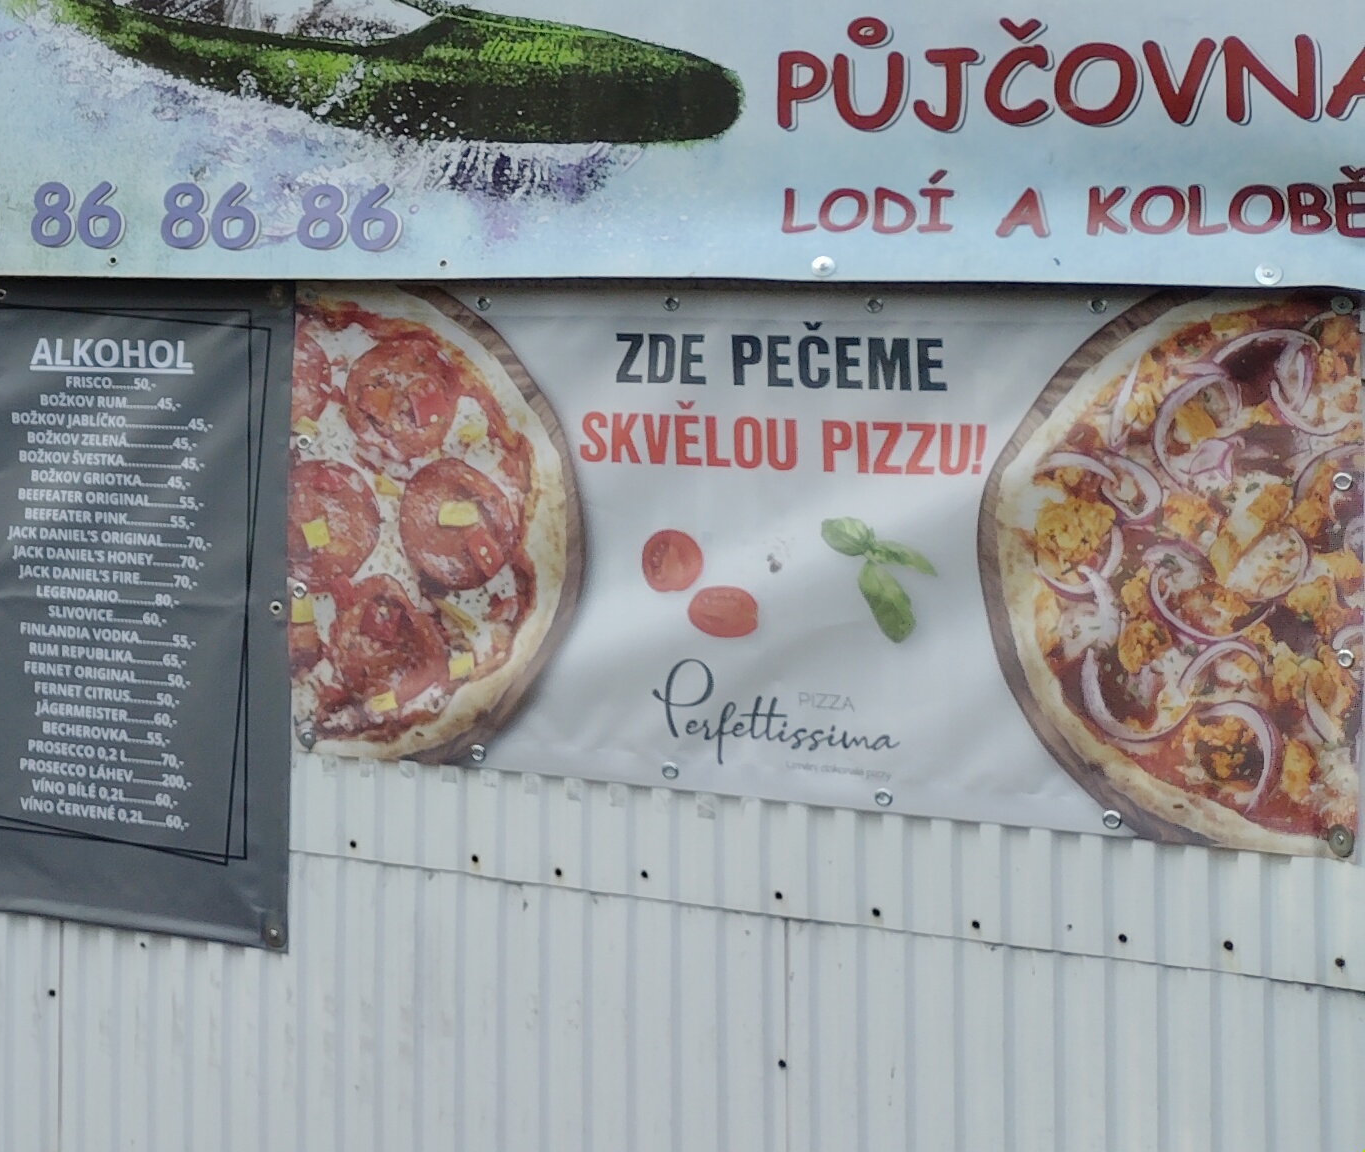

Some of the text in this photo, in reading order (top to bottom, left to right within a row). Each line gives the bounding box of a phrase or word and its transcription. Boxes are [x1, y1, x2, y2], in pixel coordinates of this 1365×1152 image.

[31, 180, 124, 250] 86
[160, 180, 259, 251] 86
[296, 181, 404, 253] 86
[781, 169, 953, 237] LODÍ
[996, 187, 1049, 237] A
[30, 338, 194, 369] ALKOHOL
[615, 321, 948, 391] ZDE PEČEME
[40, 393, 95, 407] BOŽKOV
[579, 400, 987, 476] SKVĚLOU PIZZU!
[652, 658, 900, 765] Perfettissima
[798, 691, 855, 713] PIZZA
